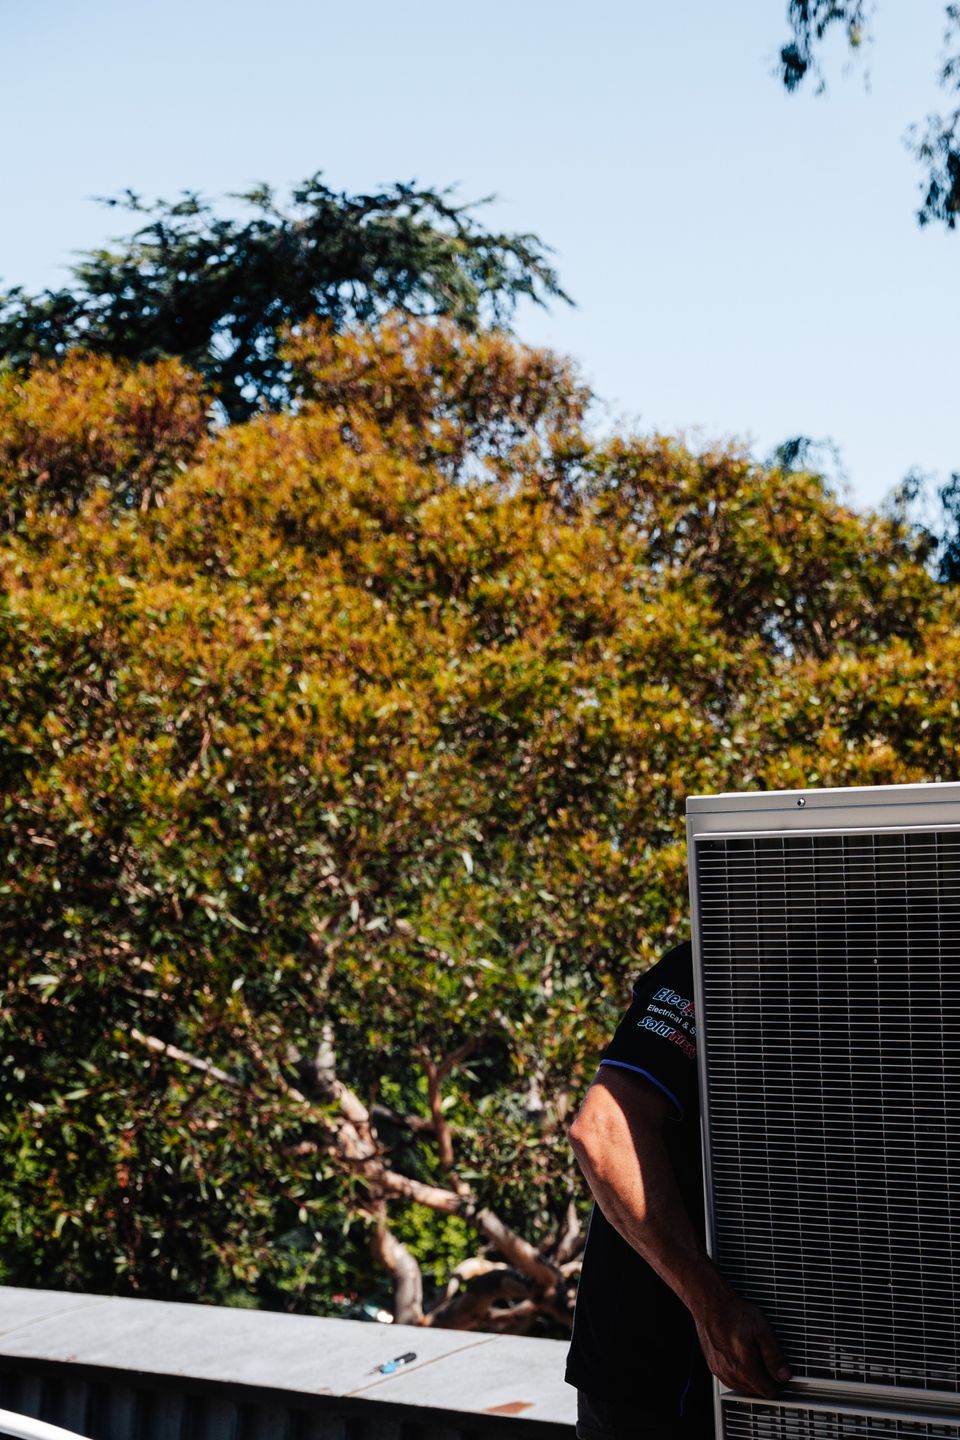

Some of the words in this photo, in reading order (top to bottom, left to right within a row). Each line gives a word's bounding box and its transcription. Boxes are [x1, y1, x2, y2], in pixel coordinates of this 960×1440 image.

[652, 987, 696, 1018] Elec
[647, 1004, 683, 1024] Electrical
[682, 1021, 690, 1030] &
